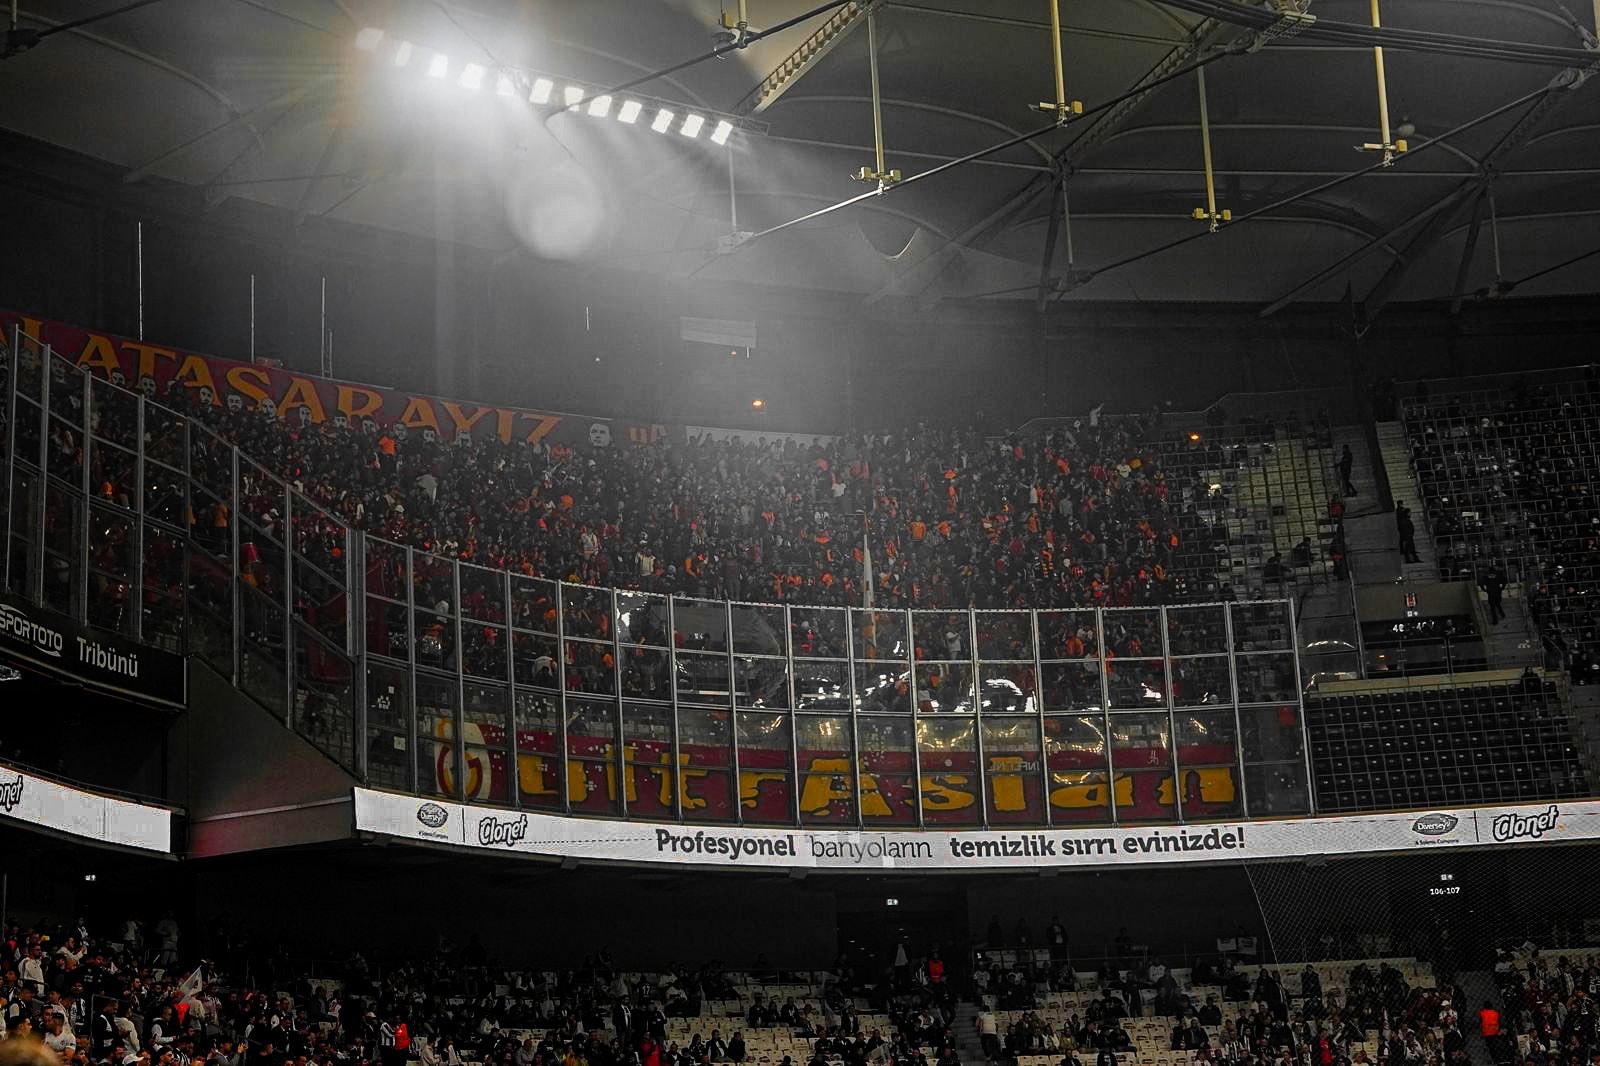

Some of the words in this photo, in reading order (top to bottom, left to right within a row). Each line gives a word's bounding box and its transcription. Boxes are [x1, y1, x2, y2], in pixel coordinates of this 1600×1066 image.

[76, 636, 139, 678] Tribünü
[479, 814, 528, 847] Clonet
[1493, 804, 1559, 842] Clonet
[655, 828, 796, 860] Profesyonel
[810, 833, 933, 864] banyoların
[950, 833, 1056, 859] temizlik
[1062, 837, 1117, 856] sırrı
[1123, 827, 1246, 854] evinizde!
[1429, 886, 1461, 895] 106-107
